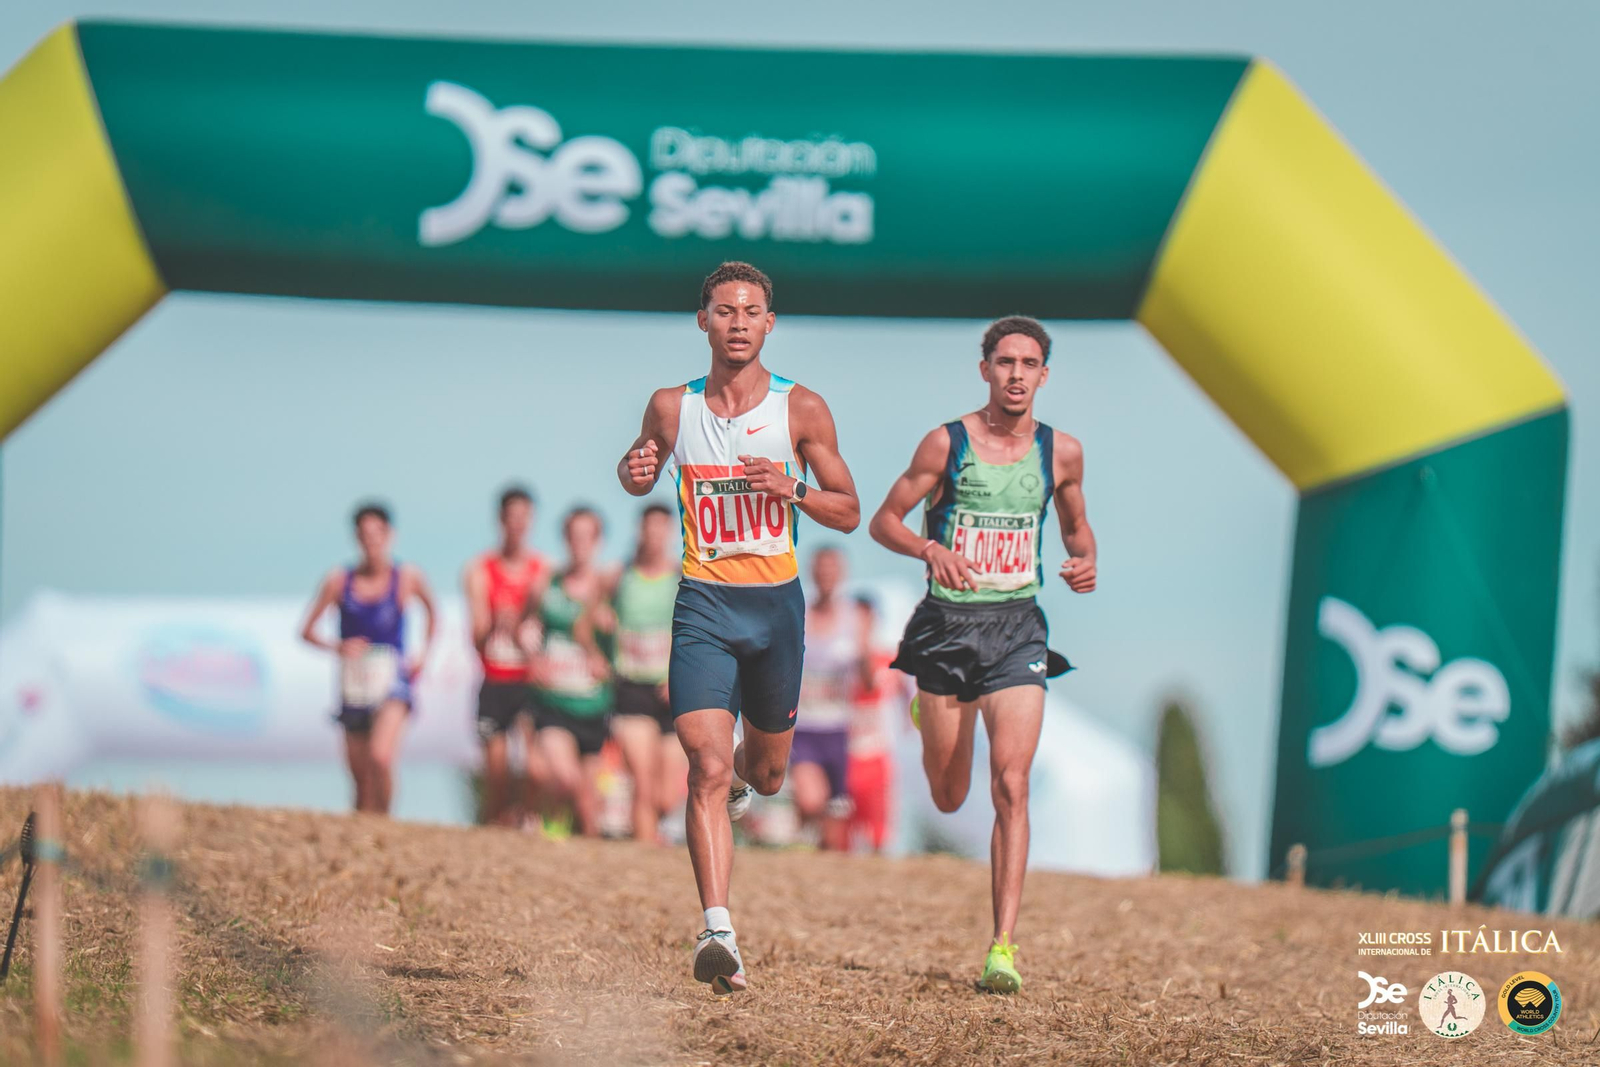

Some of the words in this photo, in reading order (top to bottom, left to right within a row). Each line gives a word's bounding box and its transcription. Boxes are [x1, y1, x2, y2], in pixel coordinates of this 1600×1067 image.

[650, 126, 877, 176] Diputación
[648, 173, 875, 243] Sevilla
[699, 493, 785, 544] OLIVO
